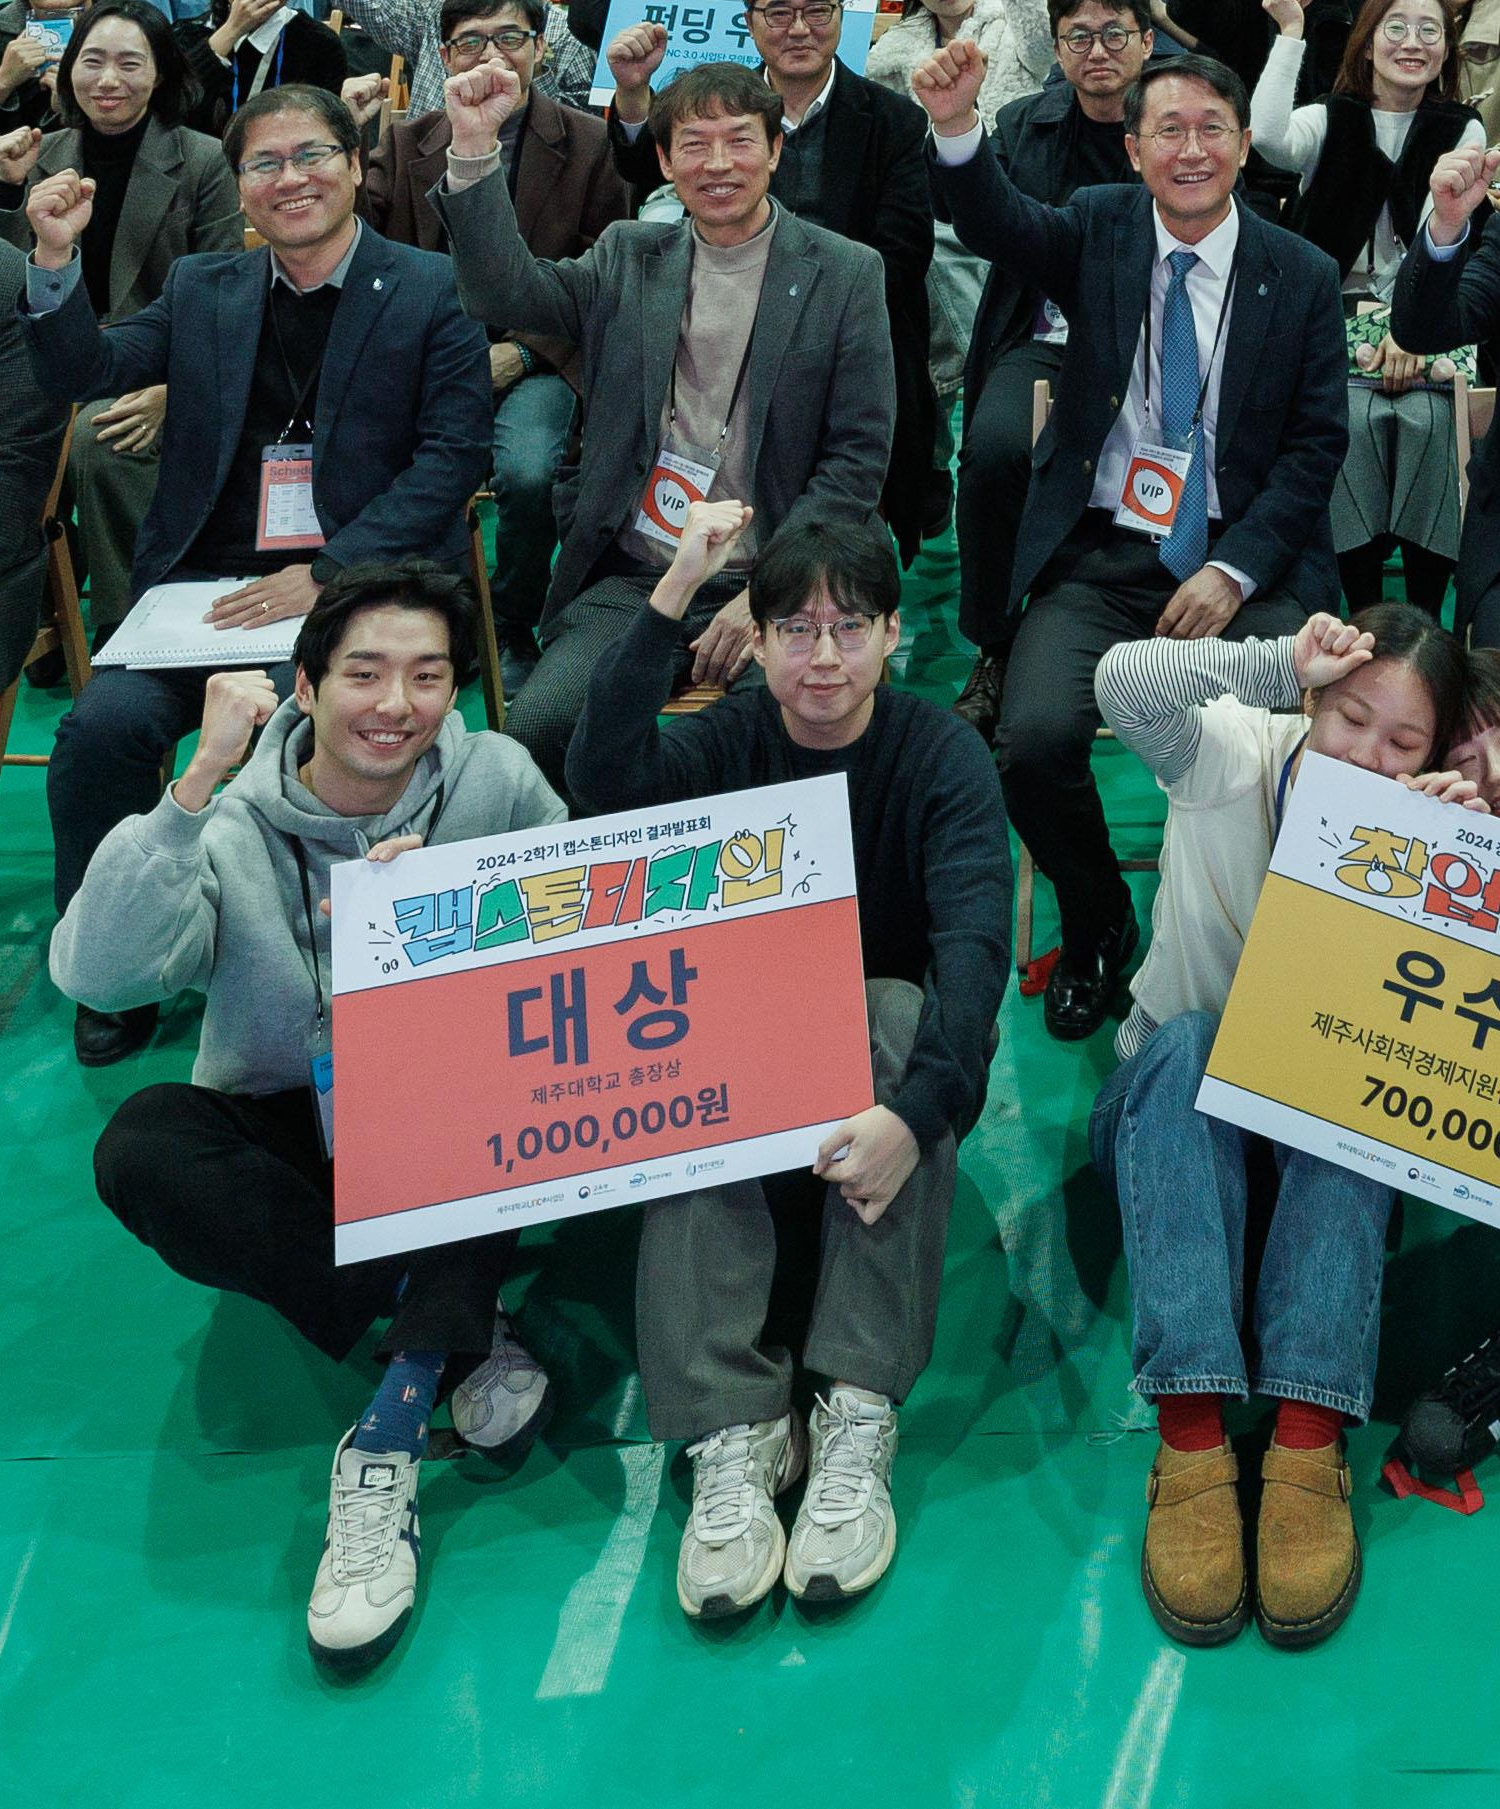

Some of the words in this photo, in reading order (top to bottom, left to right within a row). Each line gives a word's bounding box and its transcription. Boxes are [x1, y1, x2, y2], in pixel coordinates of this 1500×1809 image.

[662, 493, 685, 511] VIP
[1141, 482, 1164, 499] VIP
[476, 842, 560, 872] 2024-2학기
[562, 826, 643, 858] 캡스톤디자인
[645, 815, 712, 845] 결과발표회
[1455, 827, 1493, 852] 2024
[392, 826, 785, 968] 캡스톤디자인
[530, 1070, 622, 1106] 제주대학교
[628, 1058, 683, 1092] 총장상
[486, 1082, 731, 1174] 1,000,000원
